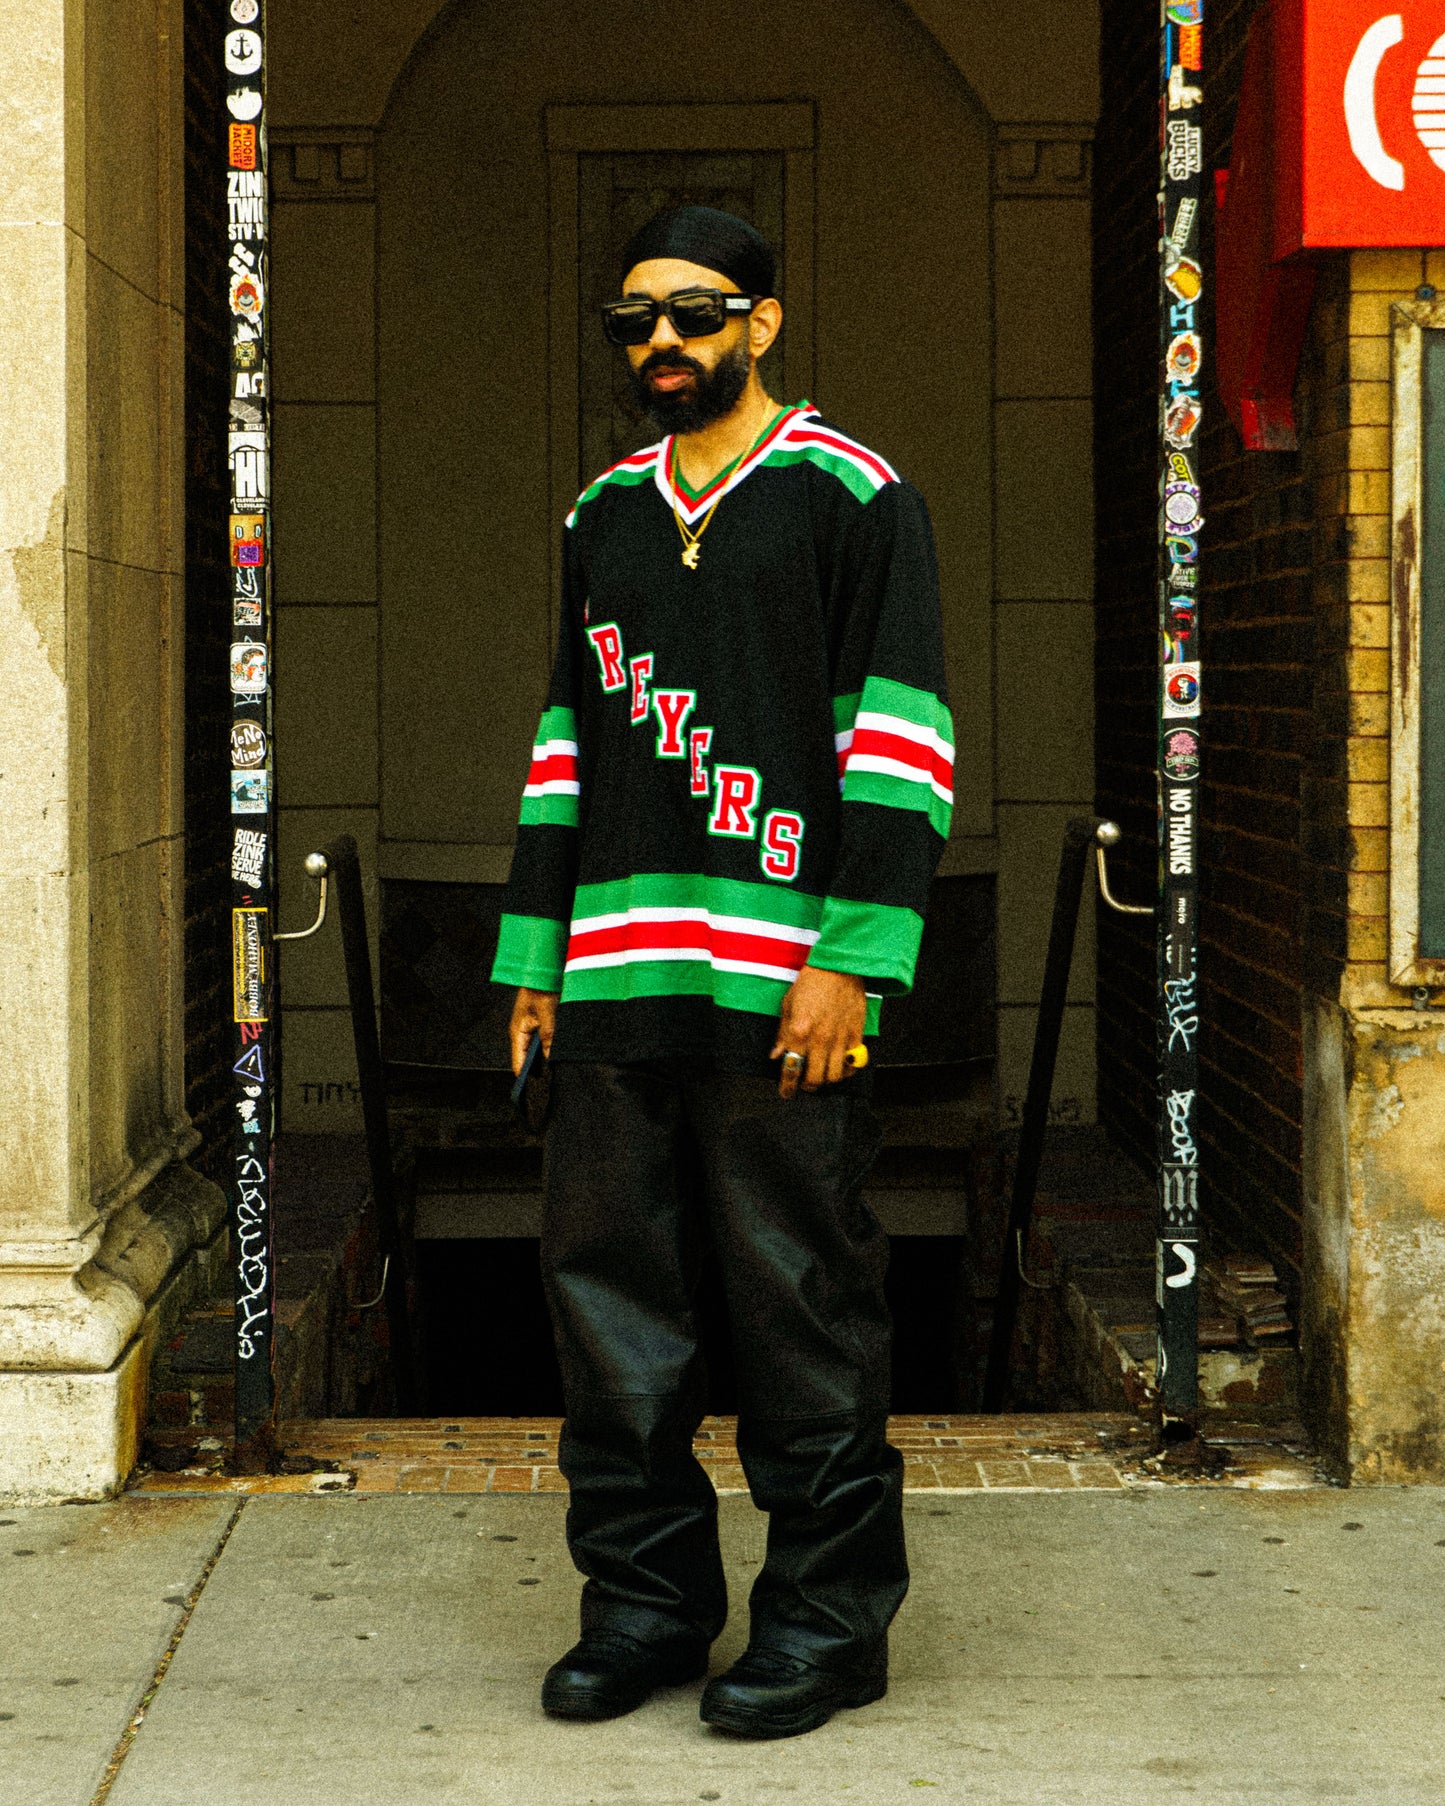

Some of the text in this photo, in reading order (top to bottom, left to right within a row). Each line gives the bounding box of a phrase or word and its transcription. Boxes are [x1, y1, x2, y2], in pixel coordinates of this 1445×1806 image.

[1172, 123, 1186, 177] BUCKS
[1187, 129, 1198, 171] LUCKY
[227, 171, 264, 197] ZIN
[231, 740, 266, 766] Mind
[1170, 789, 1192, 812] NO
[231, 842, 266, 861] ZINK
[1170, 814, 1192, 875] THANKS
[230, 855, 263, 875] SERVE
[247, 913, 259, 974] MAHONEY
[248, 976, 259, 1017] BOBBY
